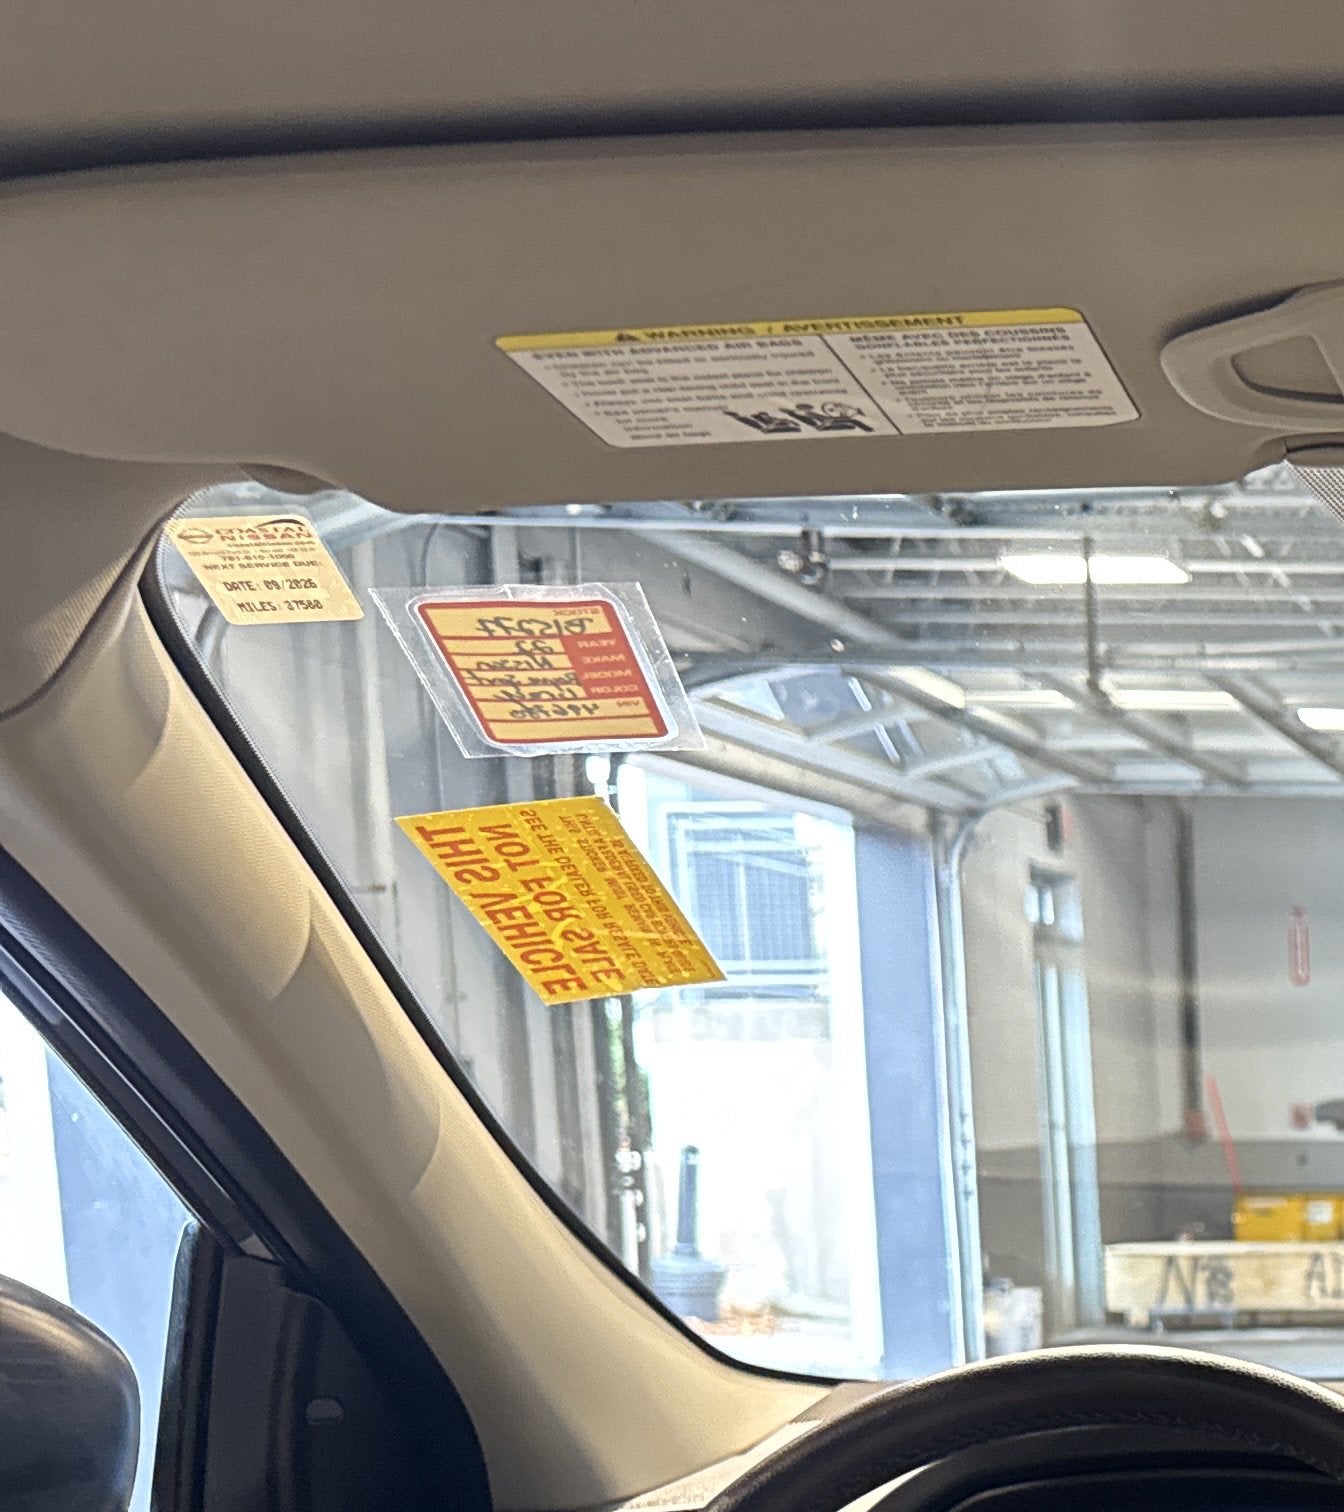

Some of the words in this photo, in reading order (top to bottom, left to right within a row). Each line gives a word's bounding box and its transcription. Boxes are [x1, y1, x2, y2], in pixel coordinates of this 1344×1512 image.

[645, 326, 756, 340] WARNING
[783, 316, 965, 333] AVERTISSEMENT
[220, 533, 313, 543] NISSAN
[204, 562, 234, 571] NEXT
[238, 561, 290, 570] SERVICE
[222, 580, 261, 593] DATE:
[263, 579, 318, 592] 09/2026
[236, 600, 281, 614] MILES:
